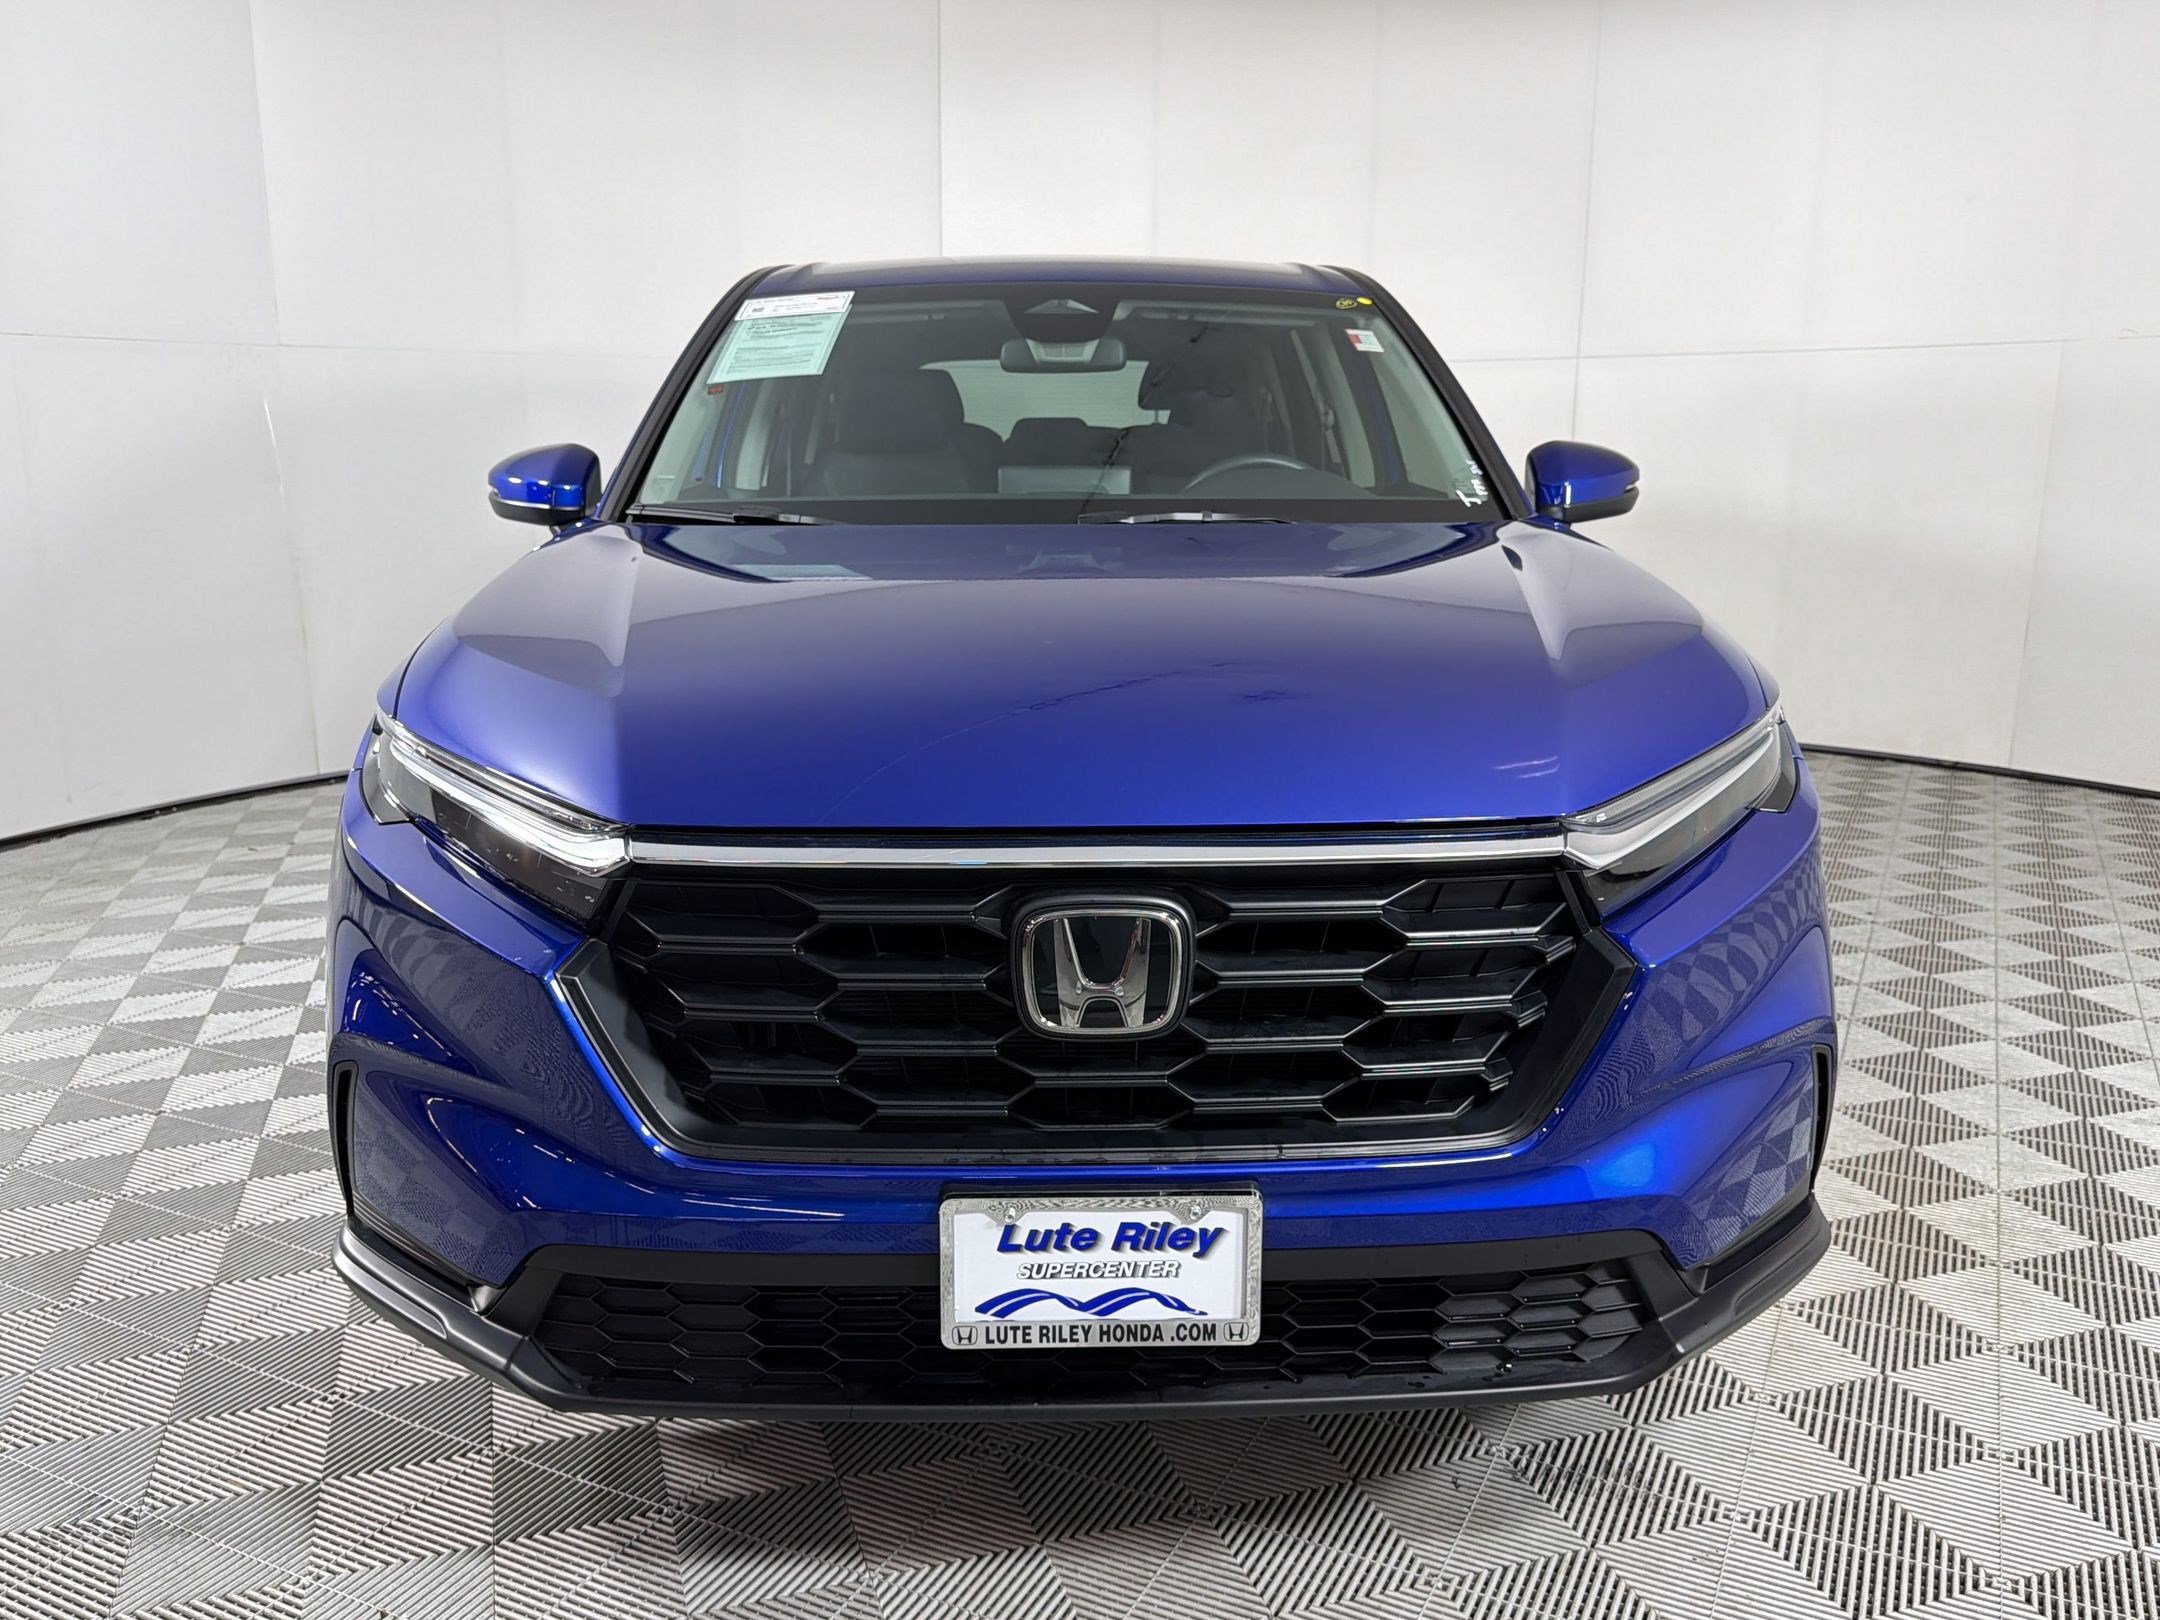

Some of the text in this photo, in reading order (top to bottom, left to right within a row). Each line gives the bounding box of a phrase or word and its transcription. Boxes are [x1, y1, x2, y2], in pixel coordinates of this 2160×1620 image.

[997, 1221, 1225, 1258] Lute Riley
[1016, 1260, 1180, 1279] SUPERCENTER
[985, 1325, 1032, 1344] LUTE
[1039, 1324, 1092, 1343] RILEY
[1099, 1323, 1164, 1342] HONDA
[1170, 1322, 1217, 1341] .COM
